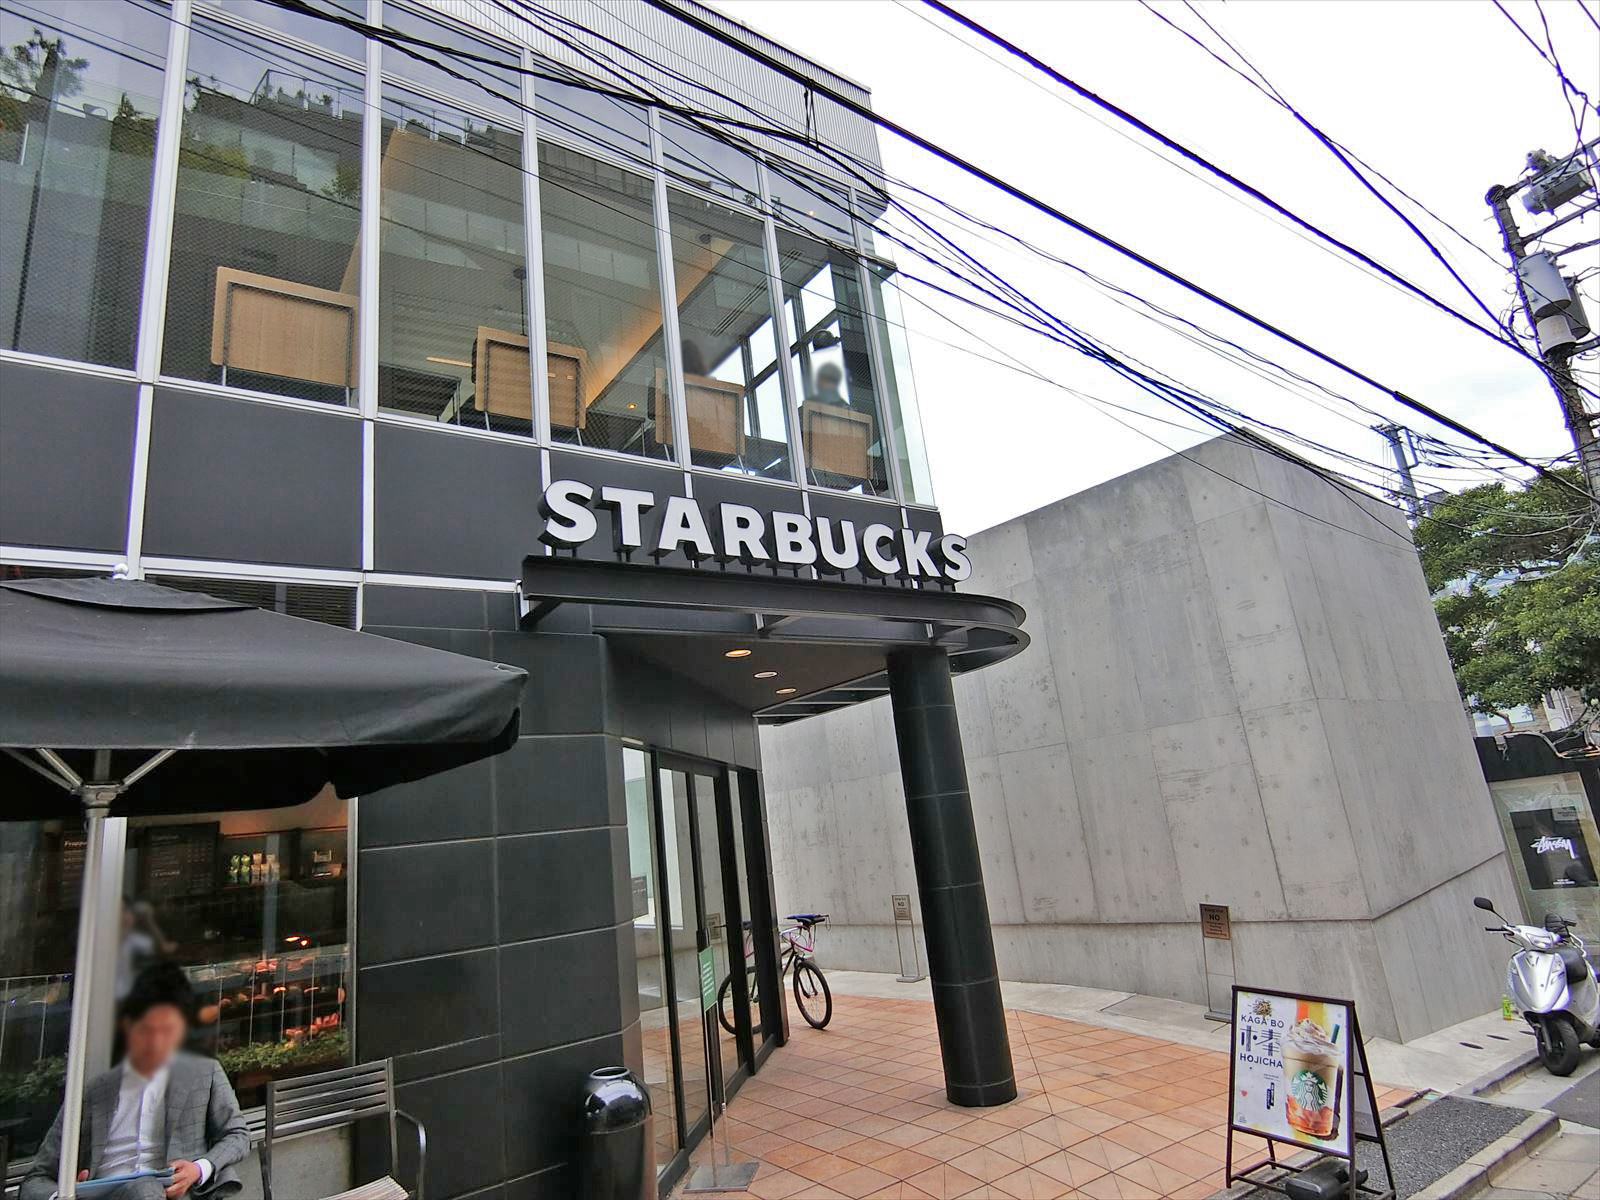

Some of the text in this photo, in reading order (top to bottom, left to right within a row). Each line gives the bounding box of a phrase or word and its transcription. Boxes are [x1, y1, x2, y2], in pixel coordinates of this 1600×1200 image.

[541, 479, 973, 583] STARBUCKS
[1208, 913, 1221, 921] NO
[1240, 1014, 1268, 1026] KAGA
[1240, 1052, 1283, 1068] HOJICHA
